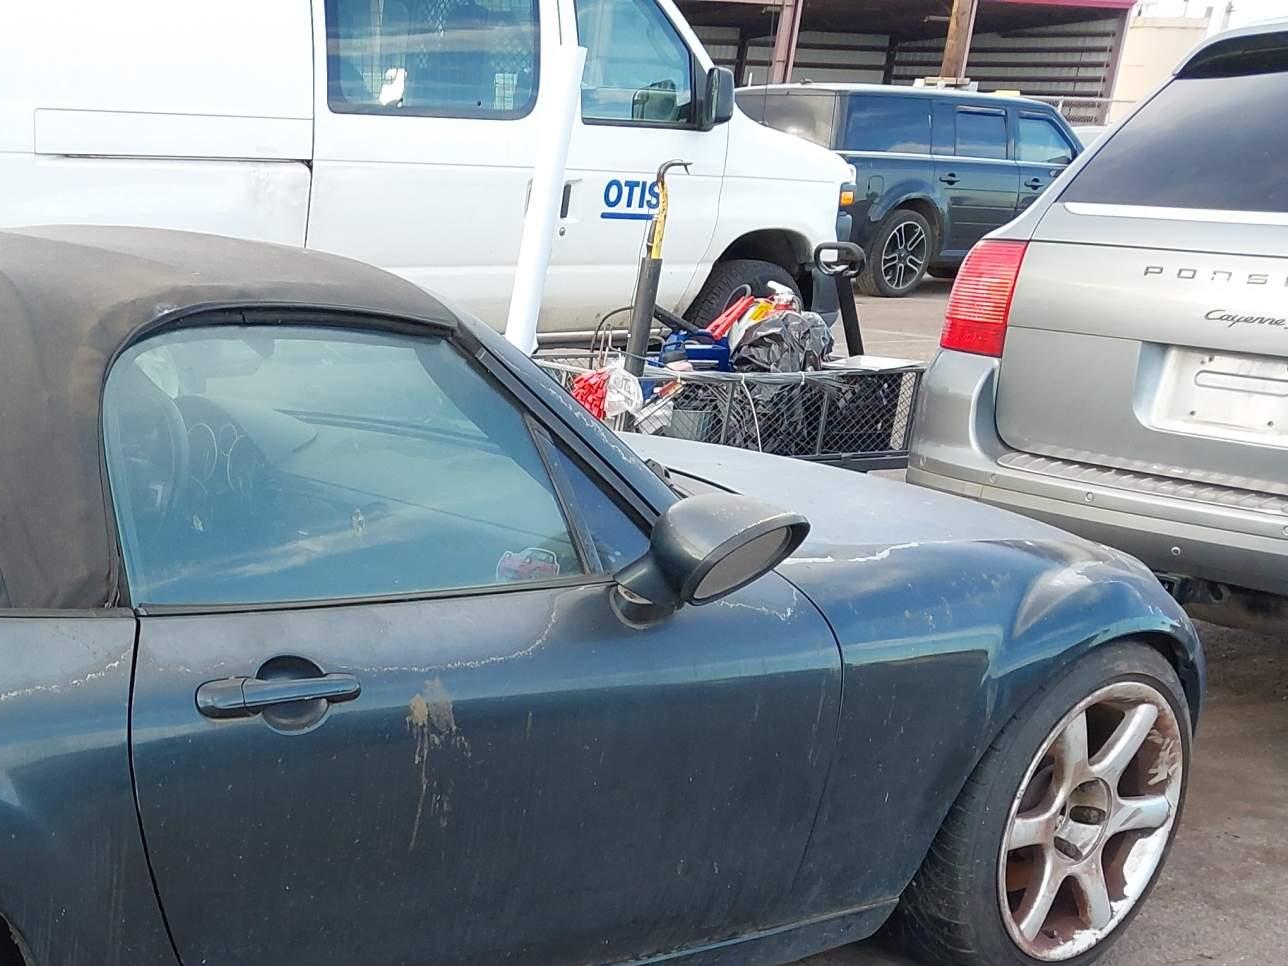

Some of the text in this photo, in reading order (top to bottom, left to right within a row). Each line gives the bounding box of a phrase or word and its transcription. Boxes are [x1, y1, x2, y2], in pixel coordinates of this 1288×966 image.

[604, 179, 660, 209] OTIS
[1143, 265, 1288, 287] PORS
[1204, 309, 1286, 328] Cayenne
